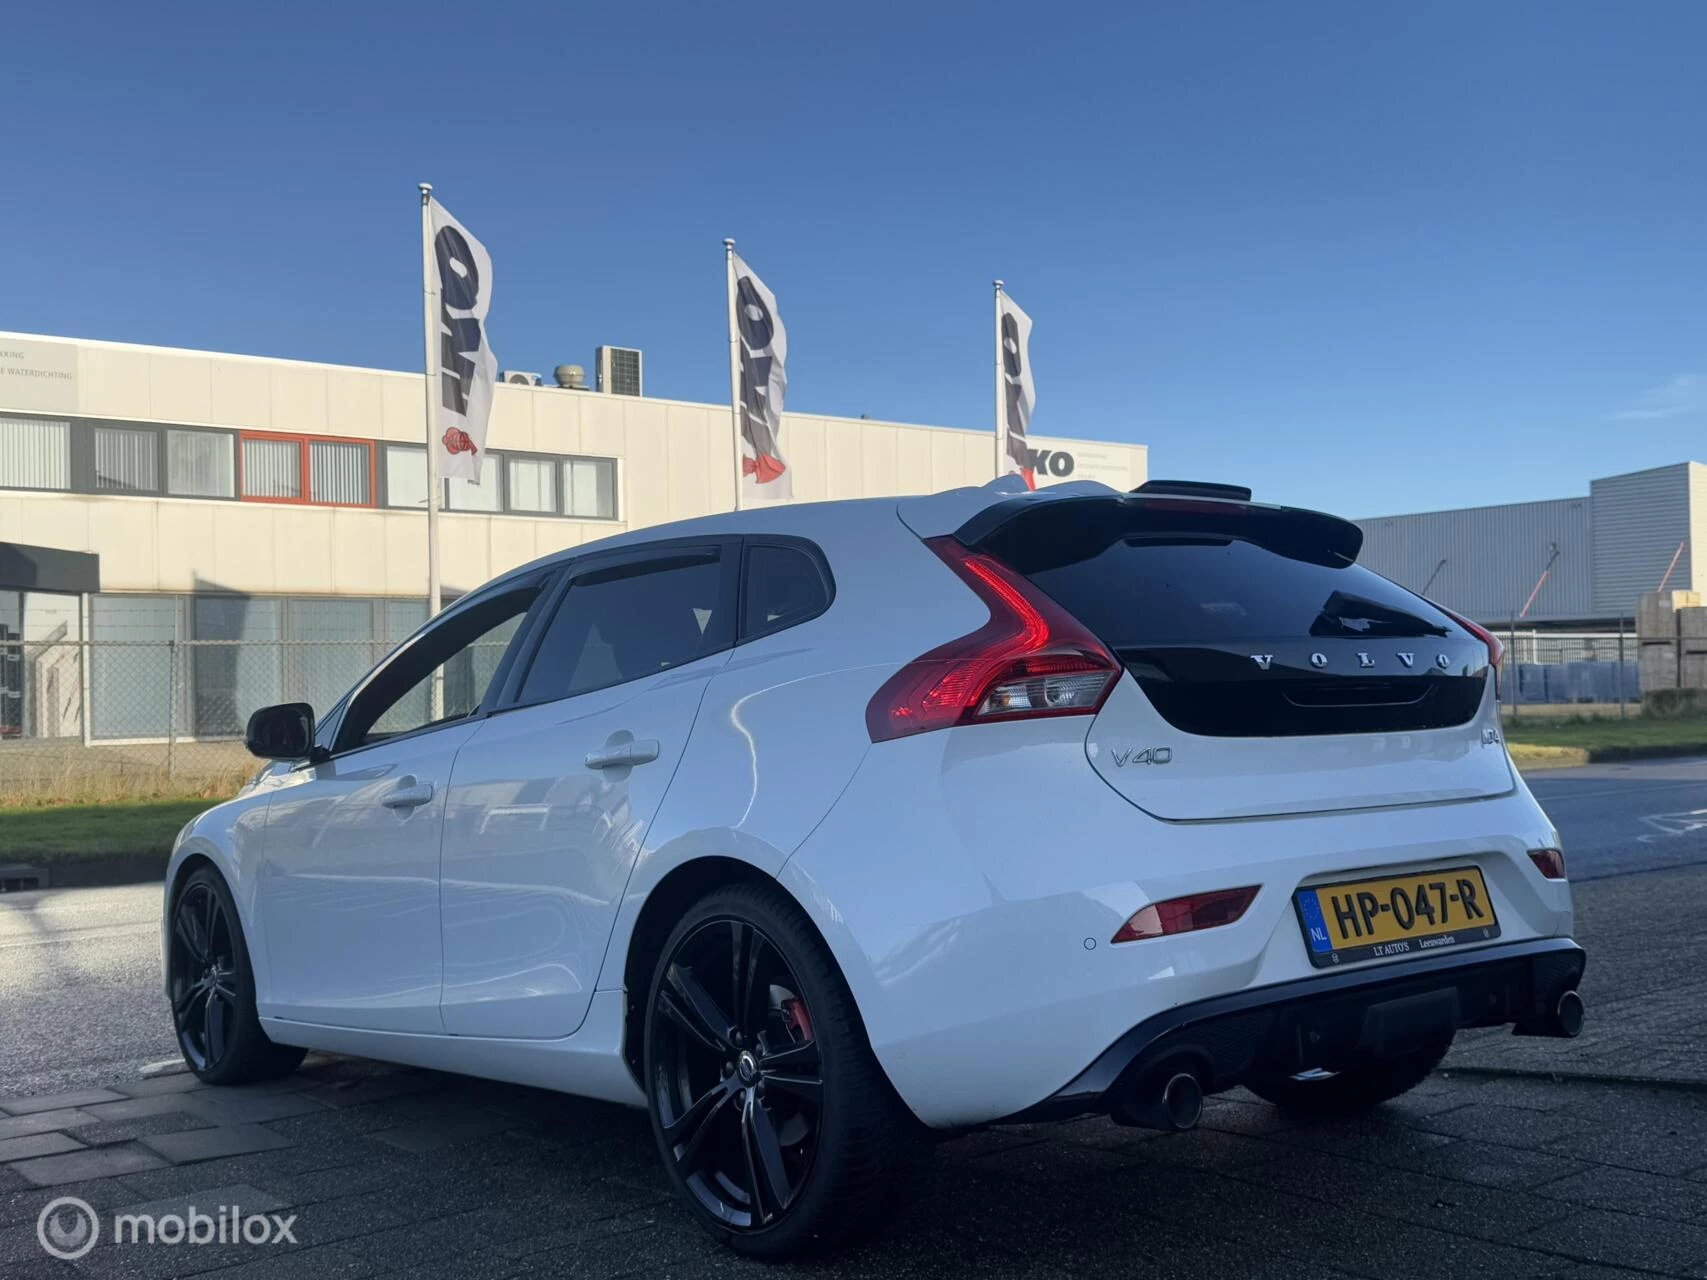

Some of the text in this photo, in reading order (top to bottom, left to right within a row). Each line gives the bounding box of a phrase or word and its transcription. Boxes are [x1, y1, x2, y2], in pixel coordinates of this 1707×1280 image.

[434, 225, 481, 416] IKO
[7, 367, 72, 380] WATERDICHTING
[1251, 652, 1450, 671] VOLVO
[1111, 746, 1172, 767] V40
[1331, 879, 1484, 939] HP-047-R
[1311, 927, 1327, 942] NL
[1373, 934, 1455, 956] LT AUTO'S Leeuwarden
